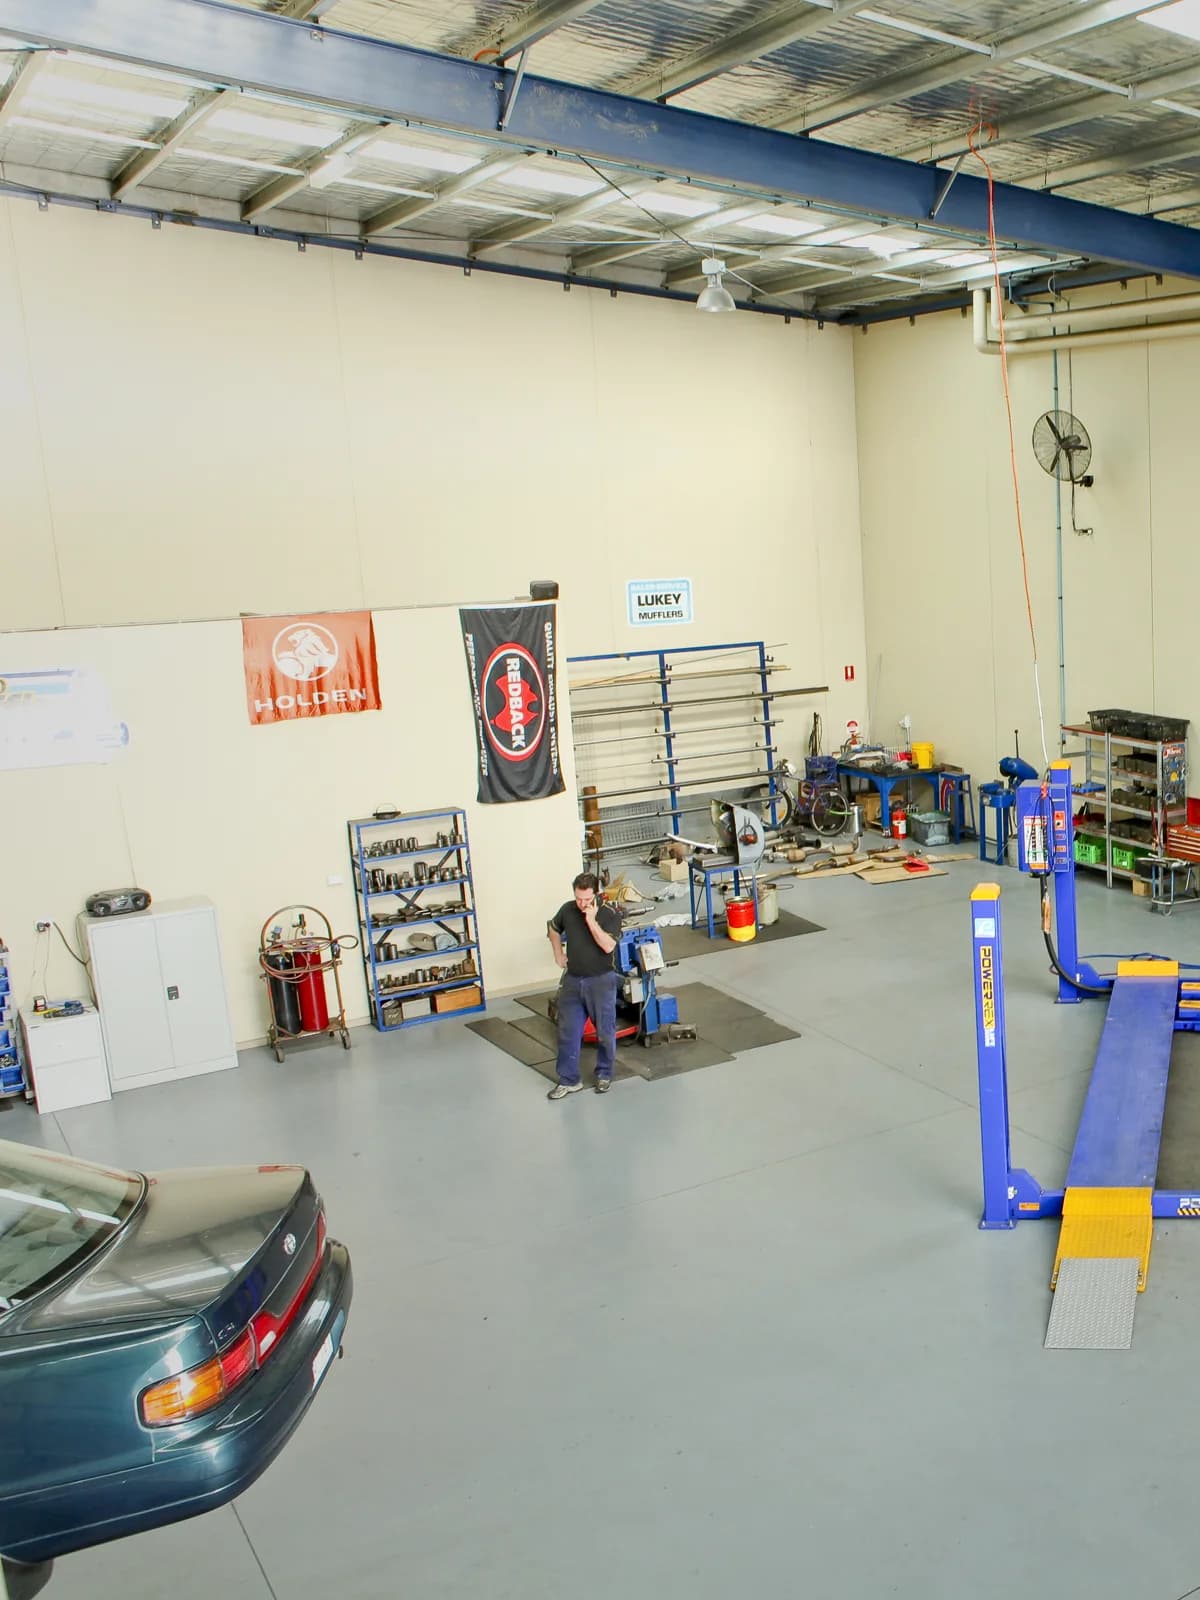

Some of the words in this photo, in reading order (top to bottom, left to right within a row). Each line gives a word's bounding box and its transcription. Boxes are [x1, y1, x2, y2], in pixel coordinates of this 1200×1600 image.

[637, 593, 681, 606] LUKEY
[638, 610, 683, 620] MUFFLERS
[544, 621, 555, 669] QUALITY
[255, 688, 367, 712] HOLDEN
[506, 657, 526, 749] REDBACK
[981, 947, 994, 1028] POWERREX
